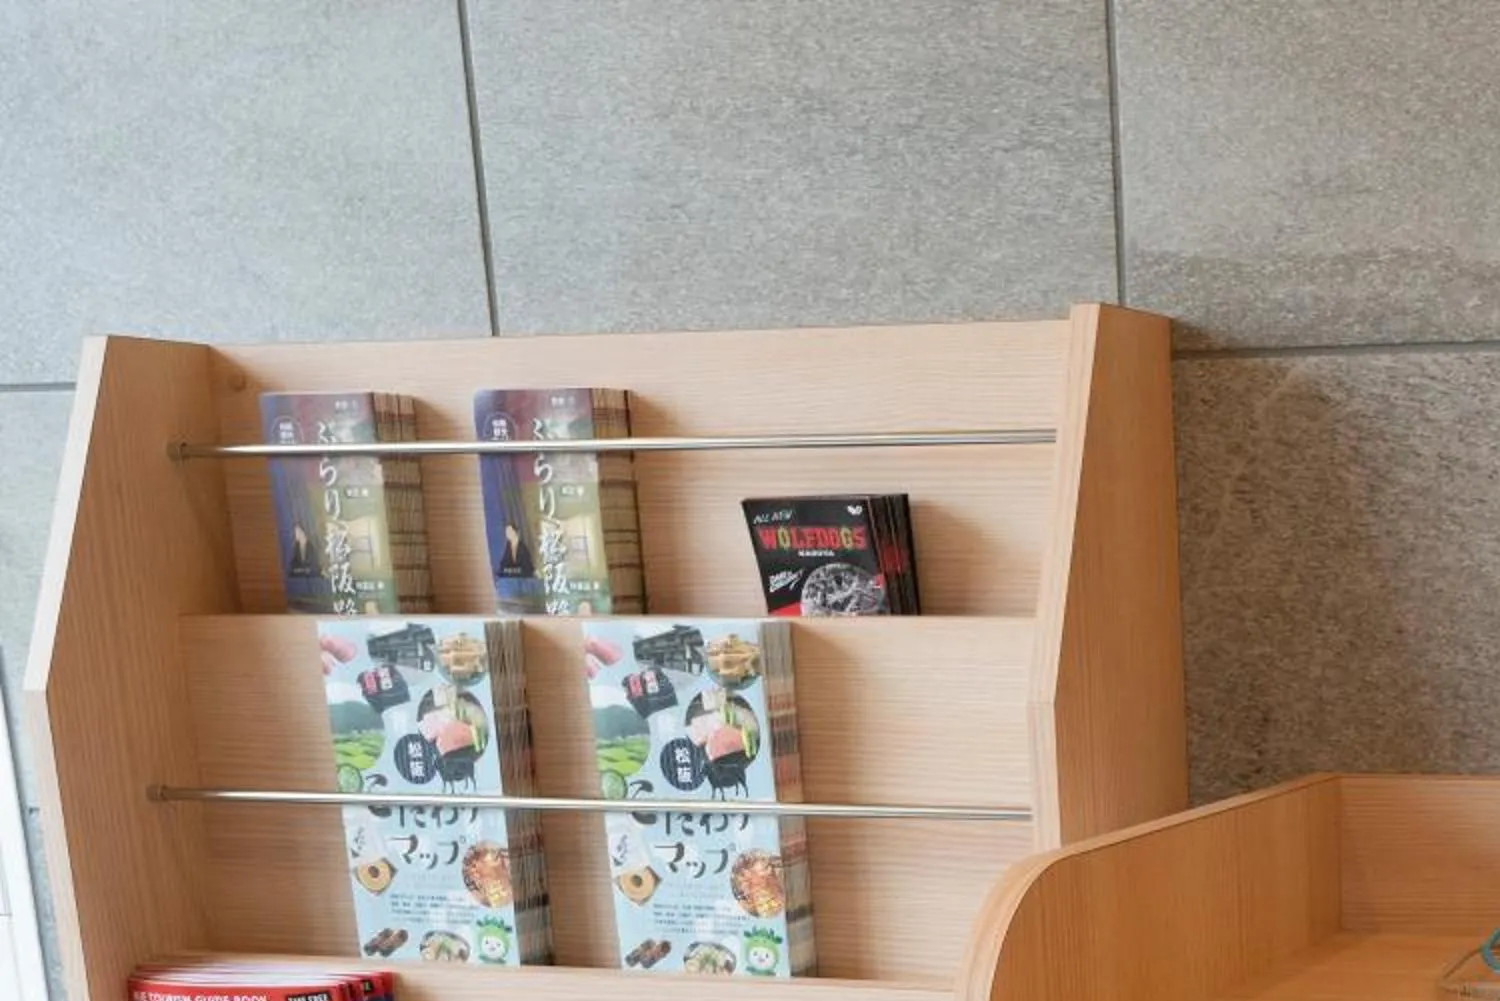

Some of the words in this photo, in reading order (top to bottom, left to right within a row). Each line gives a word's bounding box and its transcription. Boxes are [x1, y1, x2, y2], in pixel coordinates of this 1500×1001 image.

[389, 834, 467, 871] マップ
[653, 841, 737, 879] マップ
